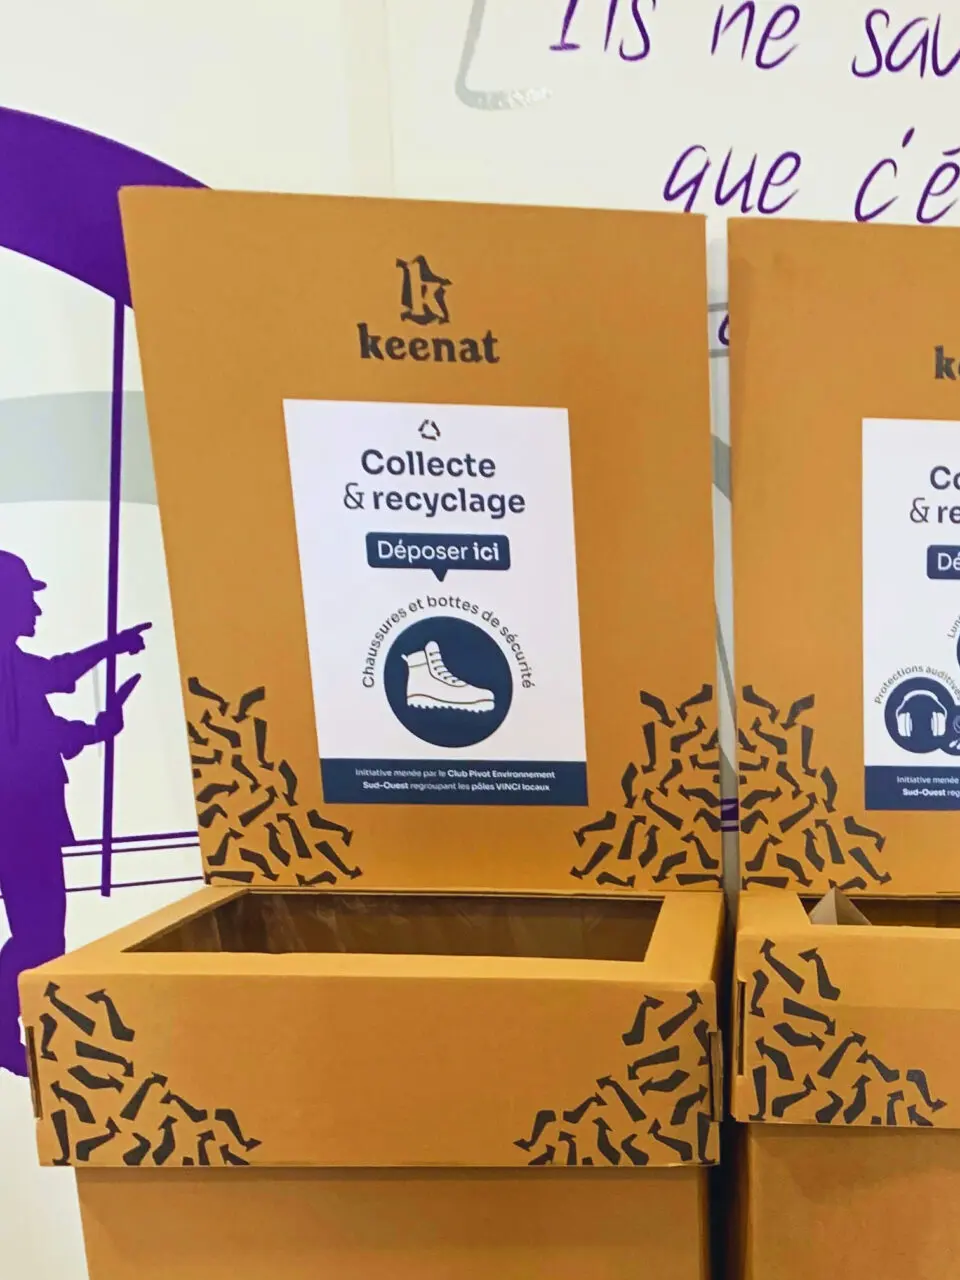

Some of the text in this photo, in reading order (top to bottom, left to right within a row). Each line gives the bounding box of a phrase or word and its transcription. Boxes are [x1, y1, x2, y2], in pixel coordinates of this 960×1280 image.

[711, 0, 800, 69] ne
[663, 145, 801, 213] que
[357, 322, 500, 363] keenat
[361, 449, 496, 478] Collecte
[343, 482, 526, 519] & recyclage
[909, 497, 930, 523] &
[377, 539, 499, 563] Déposer ici
[362, 595, 535, 689] Chaussures et bottes de sécurité
[874, 664, 924, 705] Protections
[363, 781, 550, 792] Sud-Ouest regroupant les pôles VINCI locaux
[393, 769, 421, 777] menée
[423, 771, 437, 779] par
[439, 769, 446, 777] le
[447, 769, 468, 778] Club
[469, 770, 491, 778] Pivot
[492, 770, 555, 779] Environnement
[897, 776, 931, 784] Initiative
[932, 776, 959, 785] menée
[902, 788, 946, 796] Sud-Ouest
